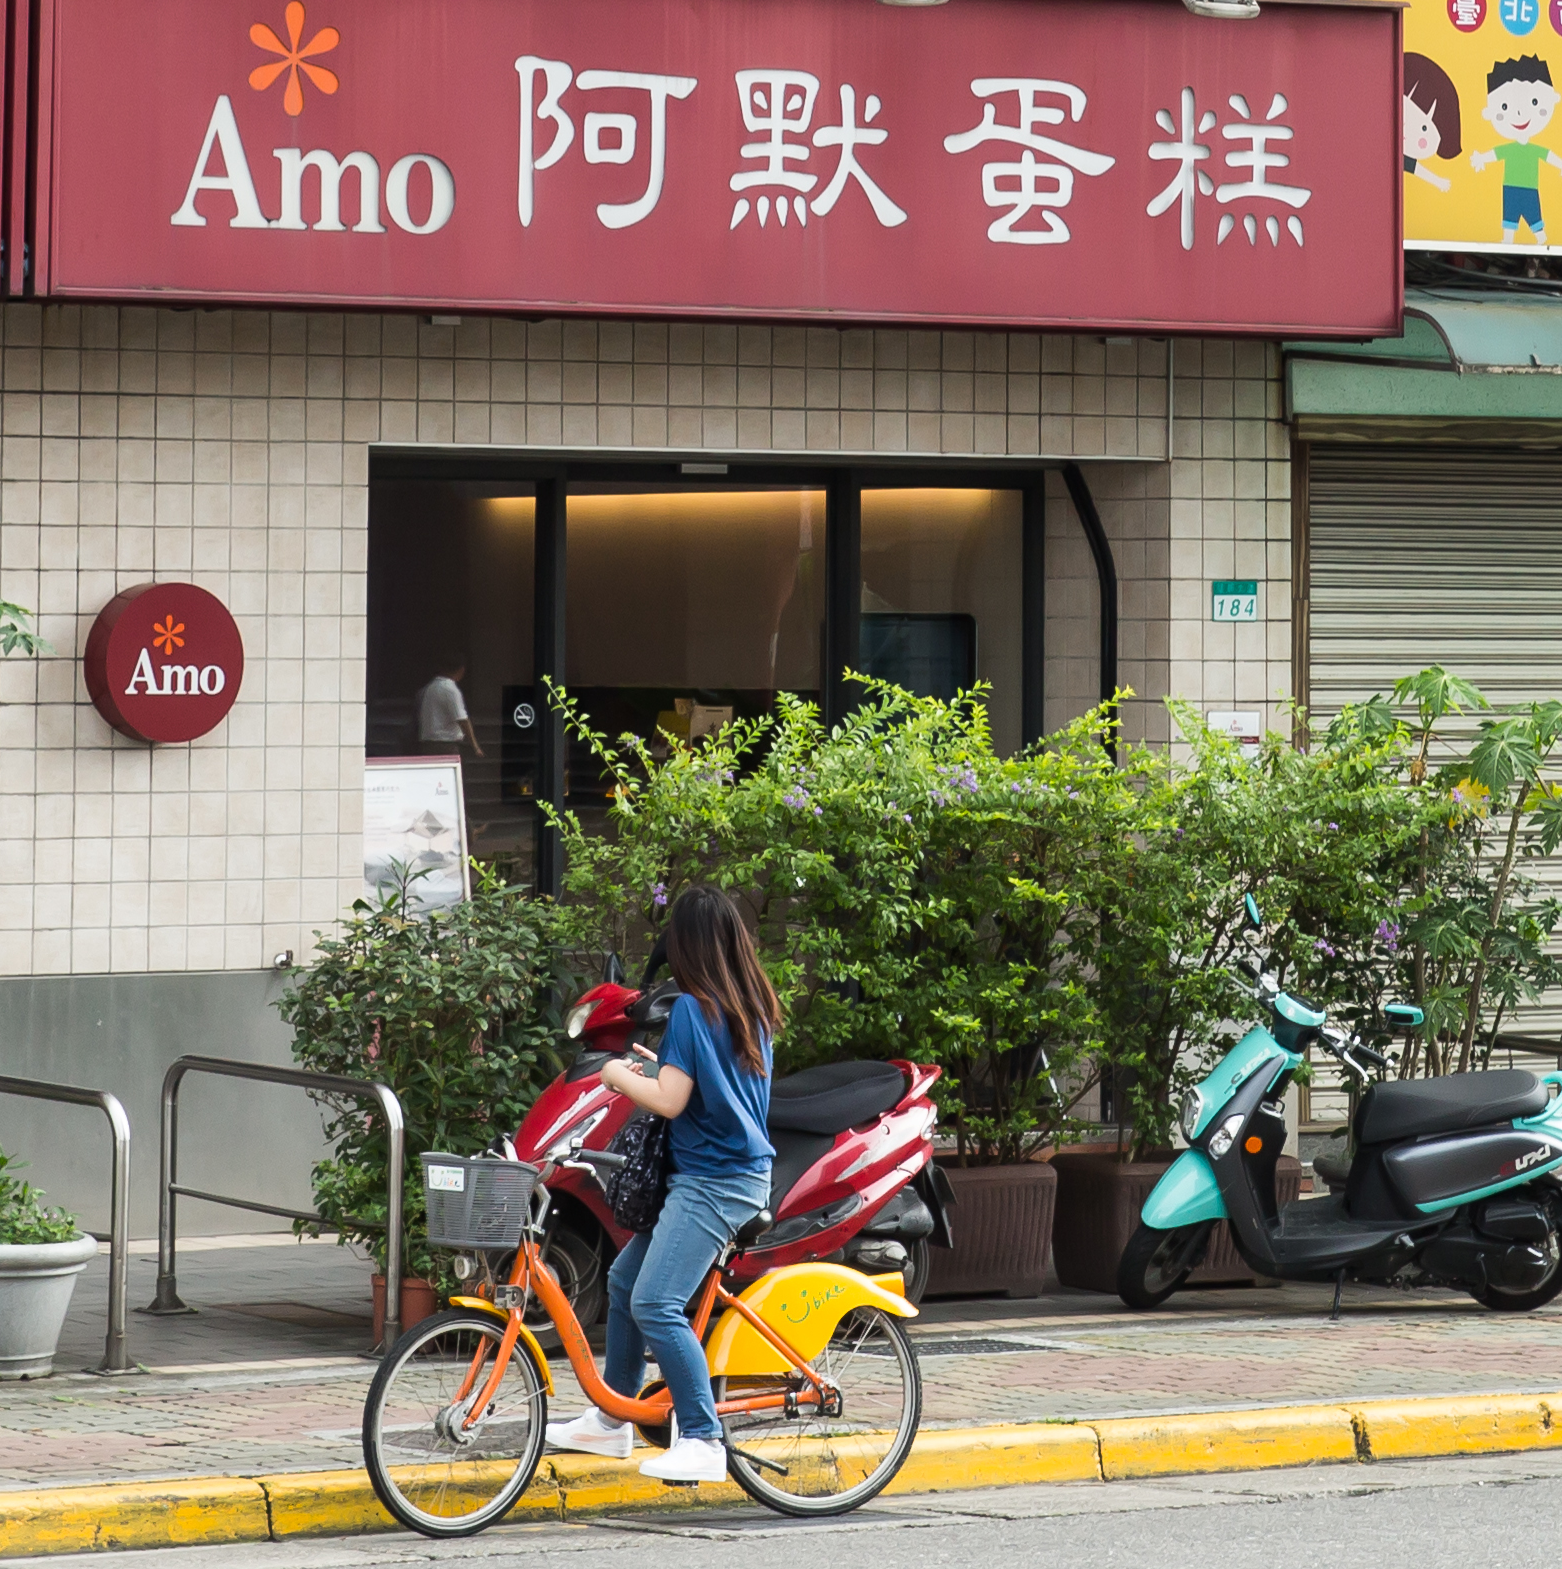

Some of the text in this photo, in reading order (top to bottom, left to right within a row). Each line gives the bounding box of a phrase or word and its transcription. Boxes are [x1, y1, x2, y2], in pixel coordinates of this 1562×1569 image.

[170, 93, 456, 235] Amo
[516, 54, 1313, 251] 阿默蛋糕
[1217, 598, 1256, 618] 184
[124, 647, 226, 696] Amo
